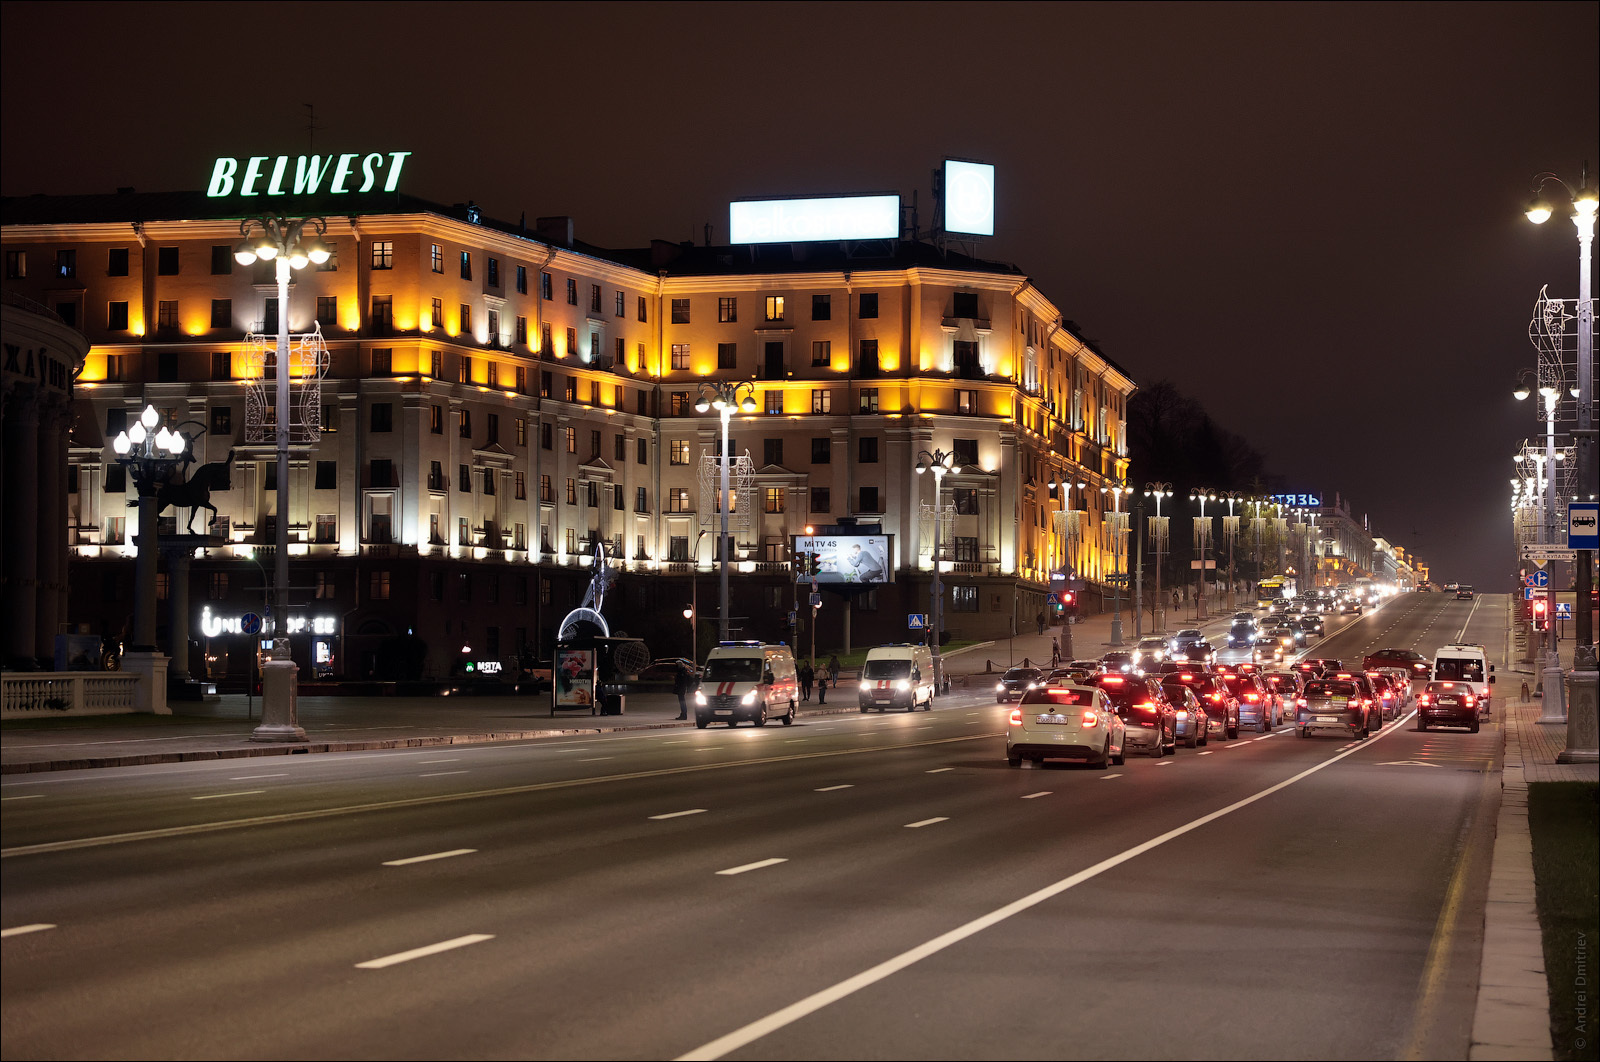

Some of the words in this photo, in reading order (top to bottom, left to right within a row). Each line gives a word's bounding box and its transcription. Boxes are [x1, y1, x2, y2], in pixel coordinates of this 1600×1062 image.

[206, 151, 412, 198] BELWEST
[1270, 494, 1320, 505] ТЯЗЬ
[477, 661, 502, 671] МЯТА
